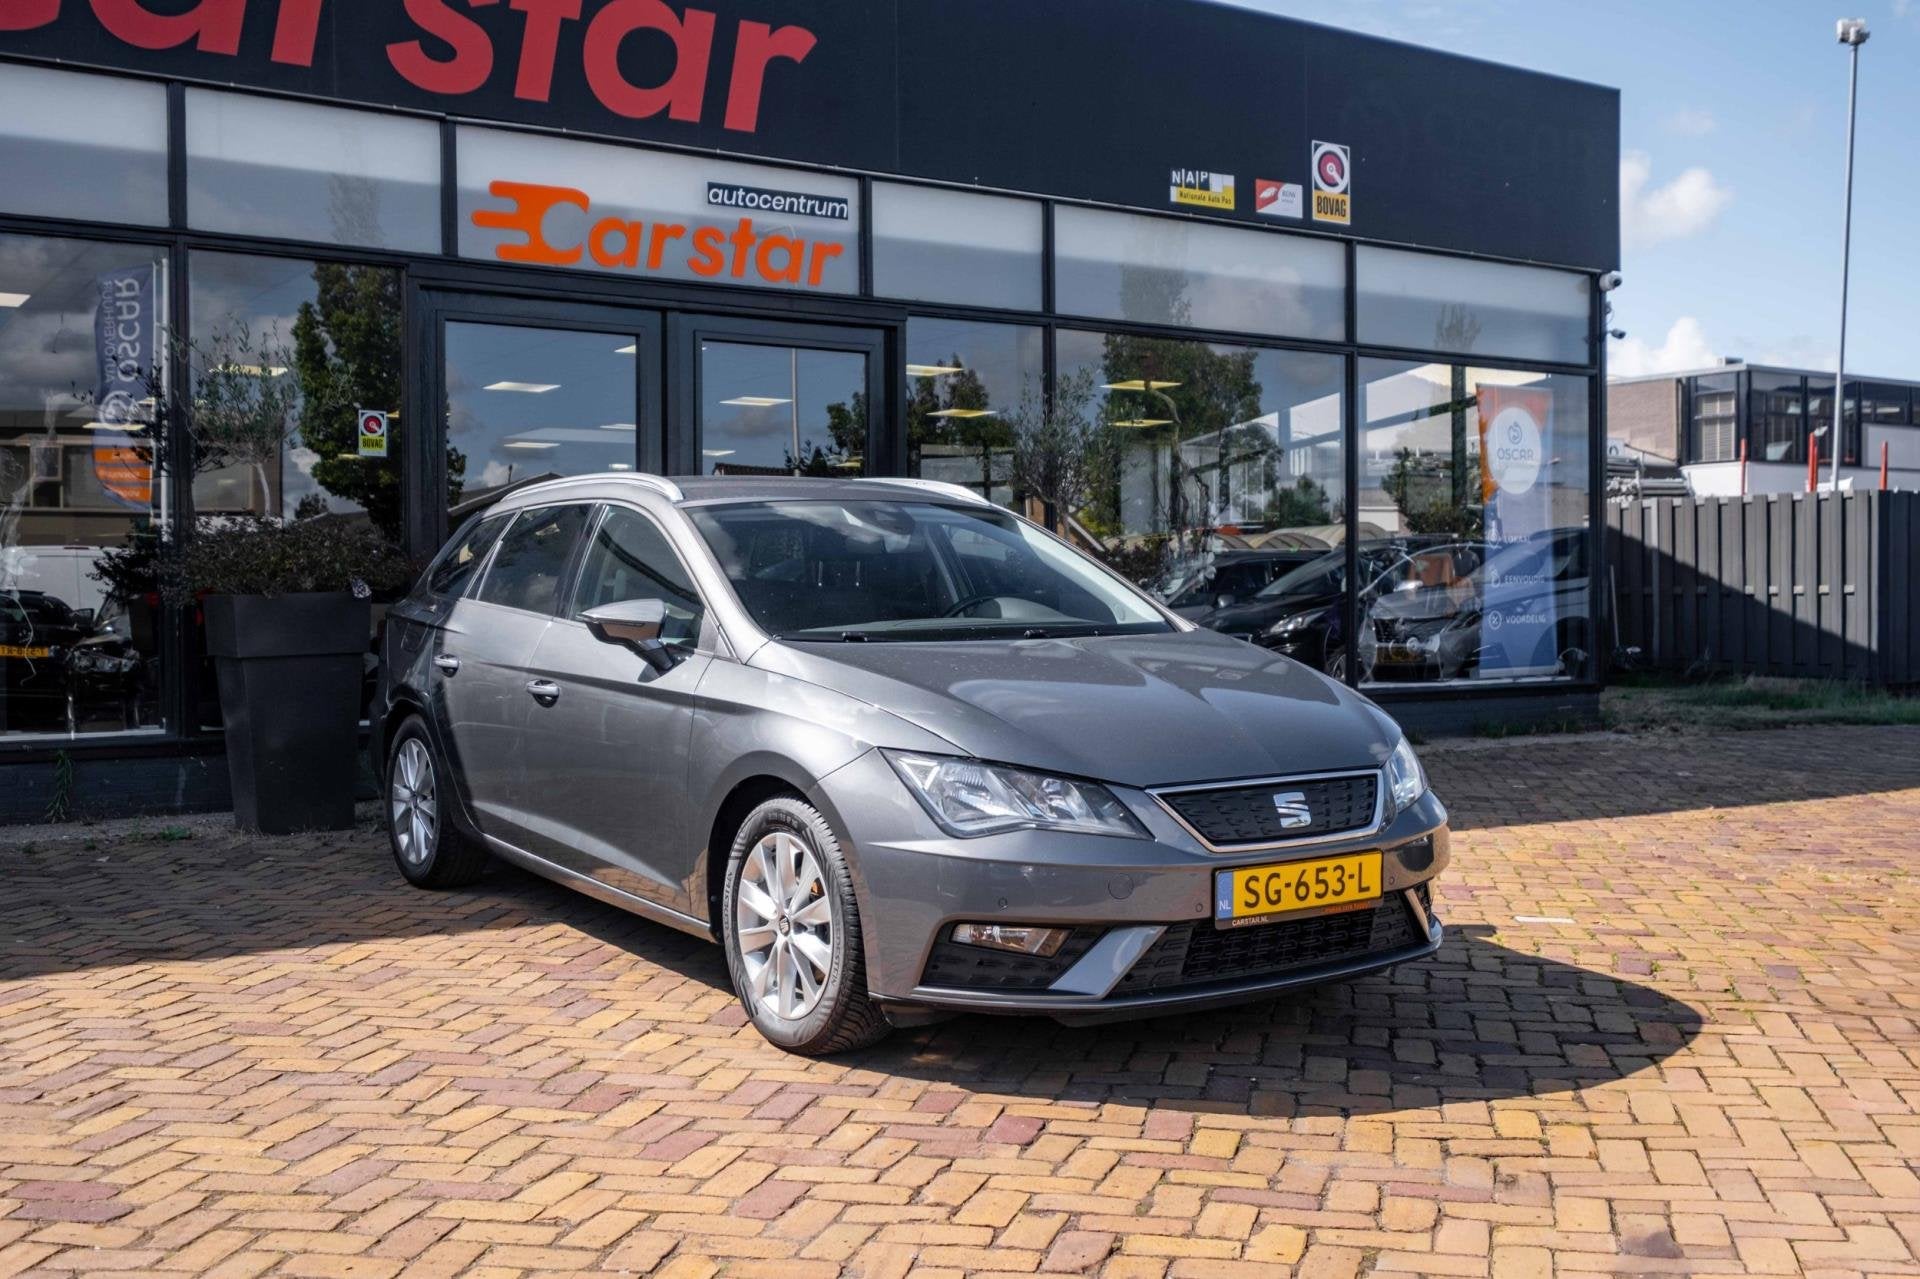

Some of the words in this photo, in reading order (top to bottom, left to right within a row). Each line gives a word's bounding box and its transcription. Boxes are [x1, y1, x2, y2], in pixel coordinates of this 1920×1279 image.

[0, 0, 816, 132] arstar
[708, 187, 848, 218] autocentrum
[1316, 195, 1347, 218] BOVAG
[471, 181, 844, 285] Carstar
[362, 438, 384, 449] BOVAG
[1496, 447, 1534, 460] OSCAR
[1505, 614, 1546, 624] VOORDELIG
[1244, 861, 1371, 909] SG-653-L
[1219, 899, 1232, 911] NL
[1231, 915, 1269, 927] CARSTAR.NL
